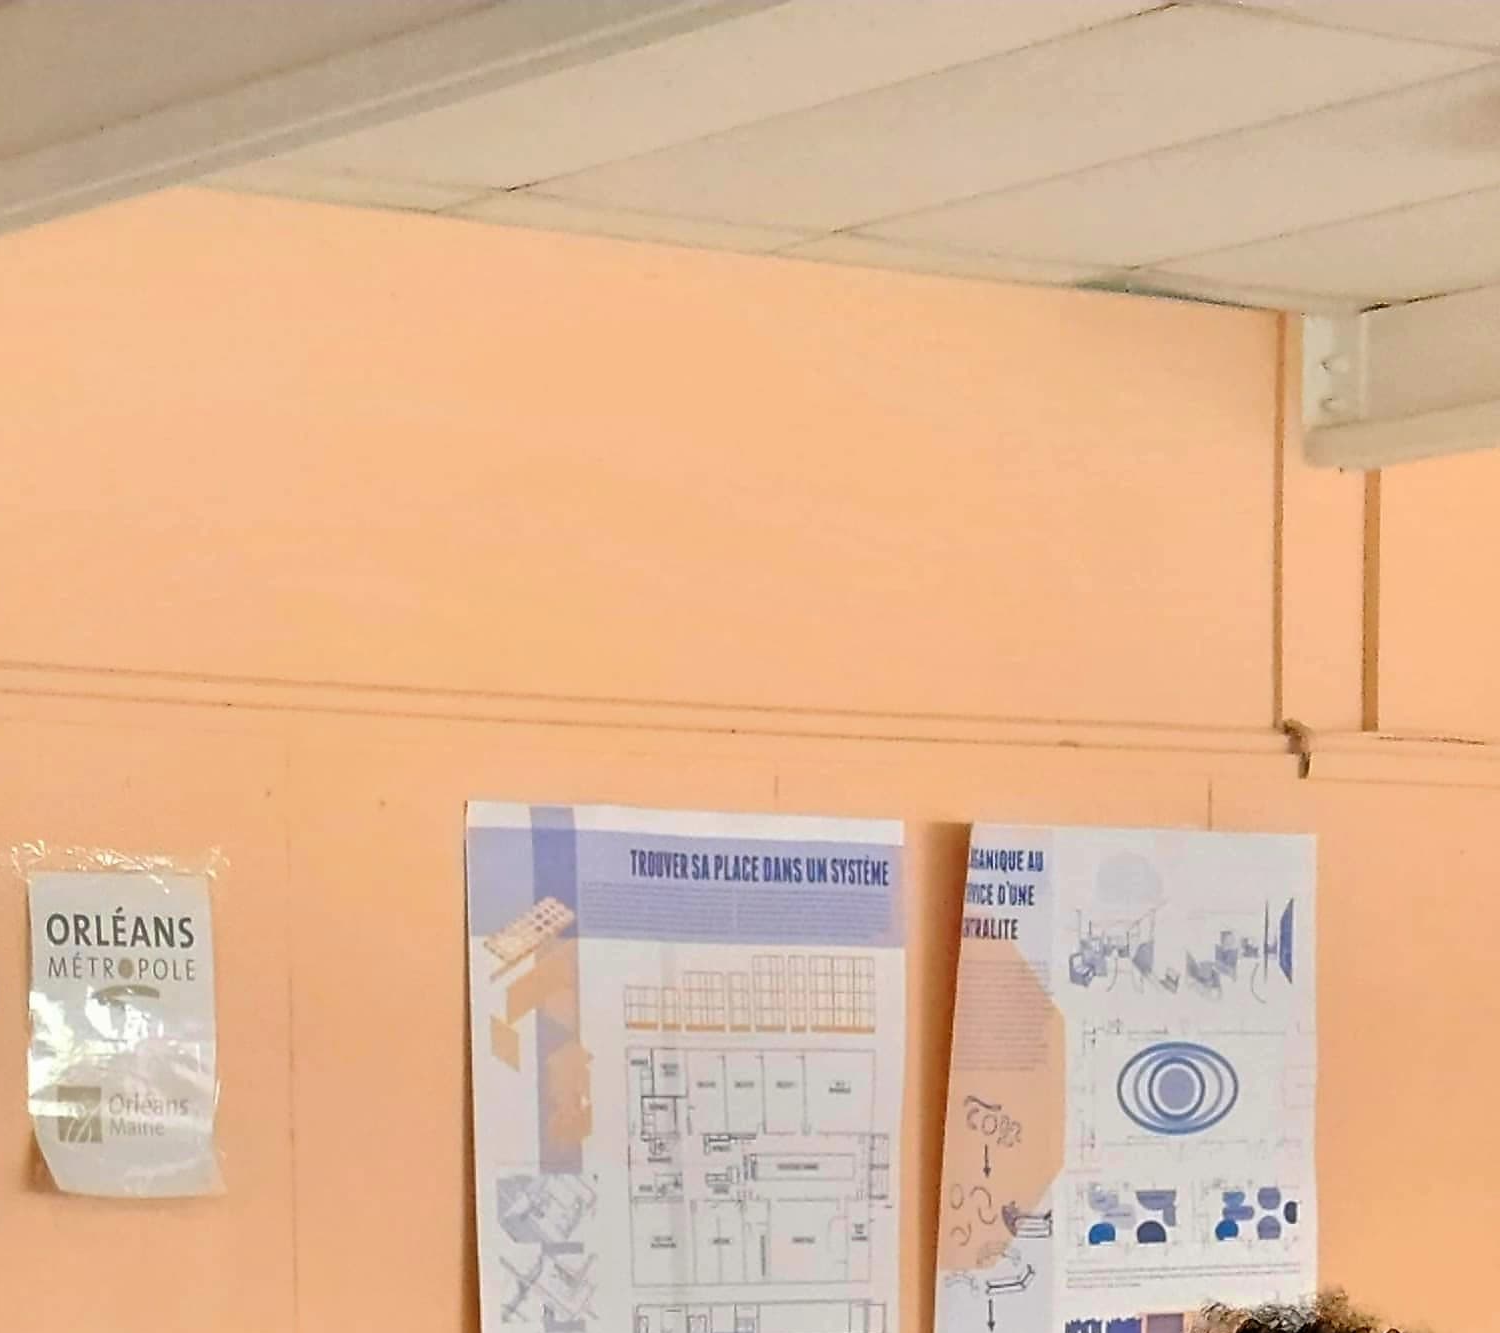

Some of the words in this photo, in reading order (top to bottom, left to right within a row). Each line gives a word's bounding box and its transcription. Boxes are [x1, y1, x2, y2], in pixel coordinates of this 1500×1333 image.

[630, 849, 689, 880] TROUVER
[691, 853, 710, 881] SA
[713, 855, 760, 883] PLACE
[762, 857, 802, 884] DANS
[806, 858, 828, 884] UN
[831, 854, 890, 887] SYSTÈME
[1027, 850, 1045, 873] AU
[46, 906, 195, 950] ORLÉANS
[48, 951, 196, 982] MÉTROPOLE
